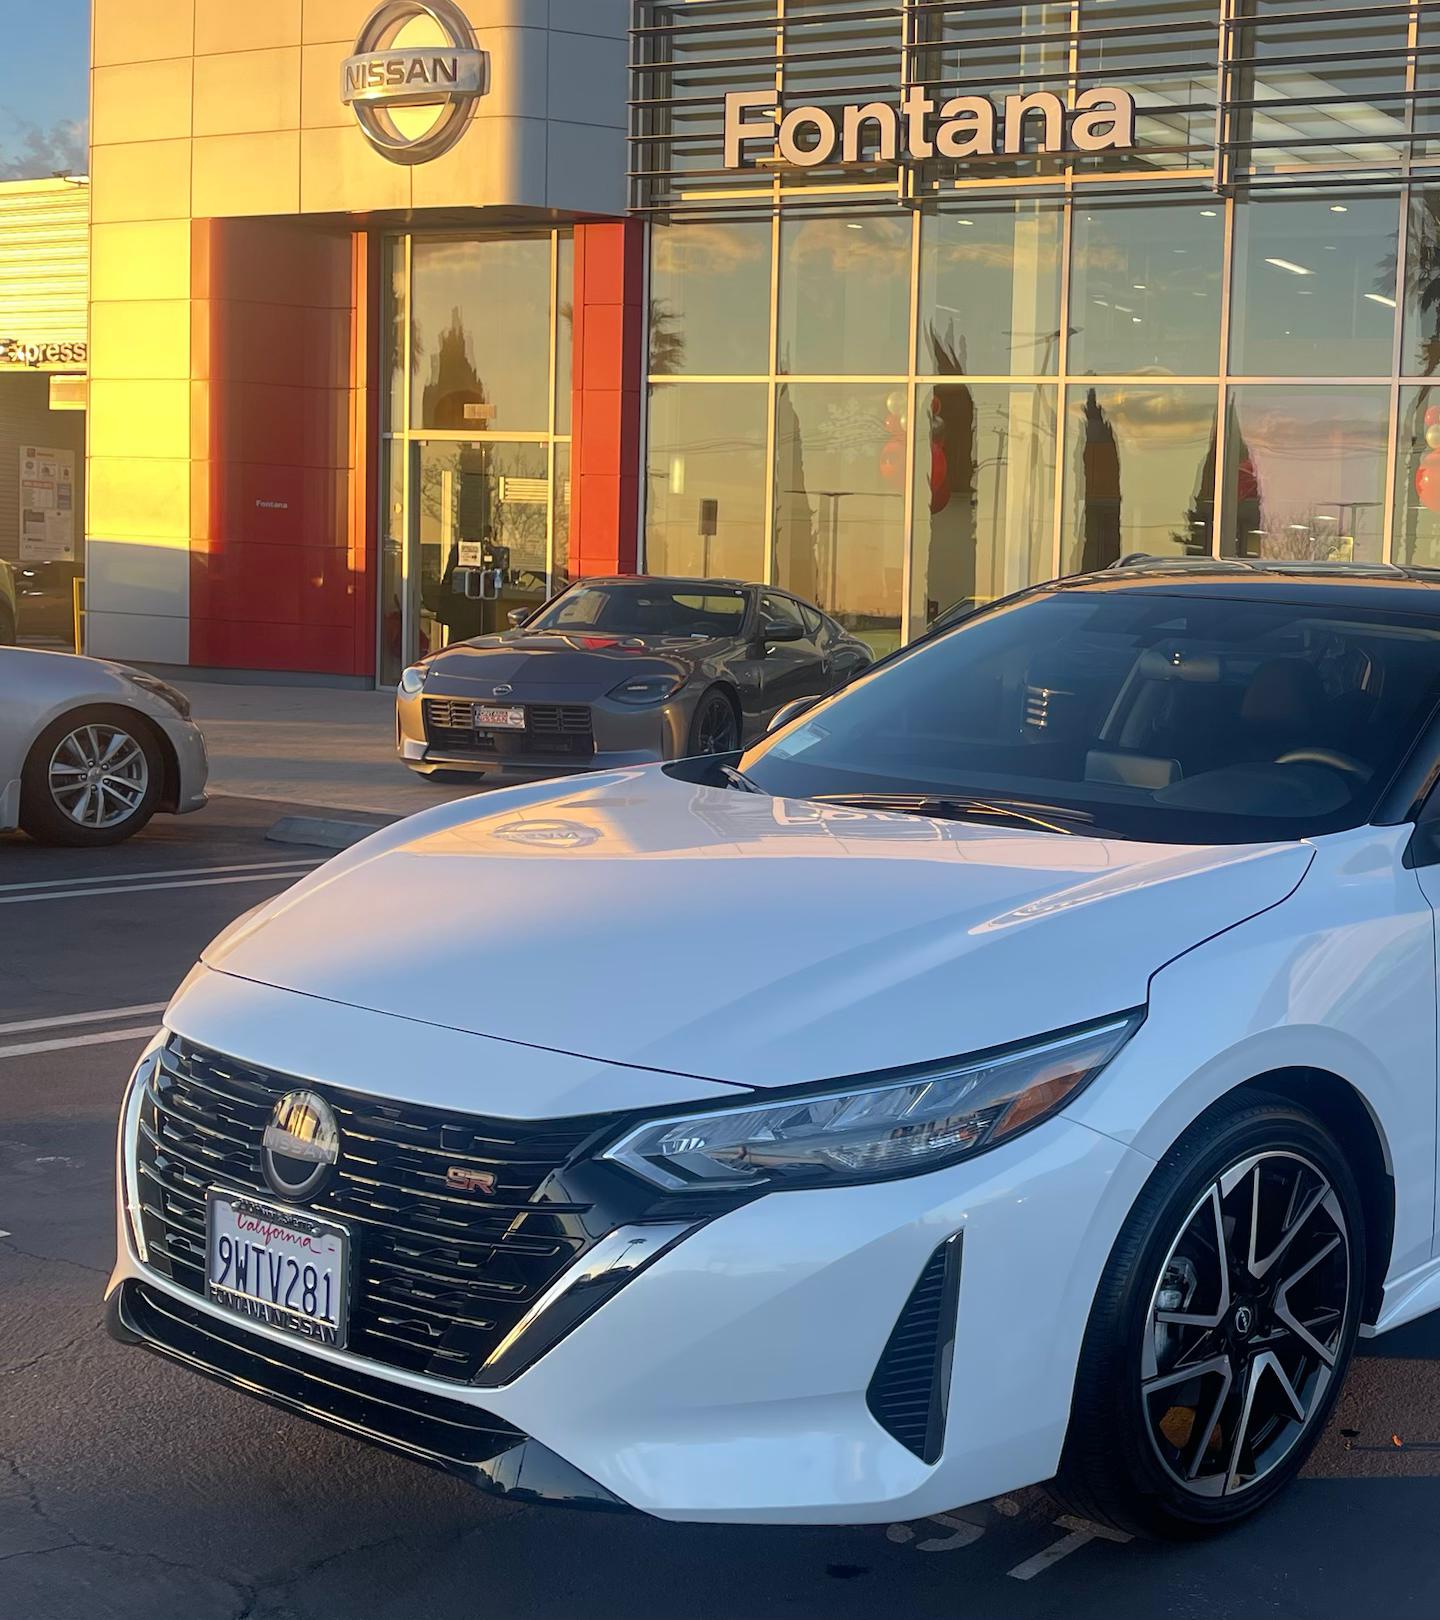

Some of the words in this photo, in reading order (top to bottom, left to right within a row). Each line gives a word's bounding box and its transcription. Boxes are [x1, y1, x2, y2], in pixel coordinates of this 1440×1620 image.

[346, 57, 459, 92] NISSAN
[723, 86, 1137, 169] Fontana
[255, 499, 288, 509] Fontana
[265, 1131, 332, 1161] NISSAN
[447, 1166, 496, 1194] SR
[237, 1212, 322, 1254] California
[218, 1233, 336, 1323] 9WTV281
